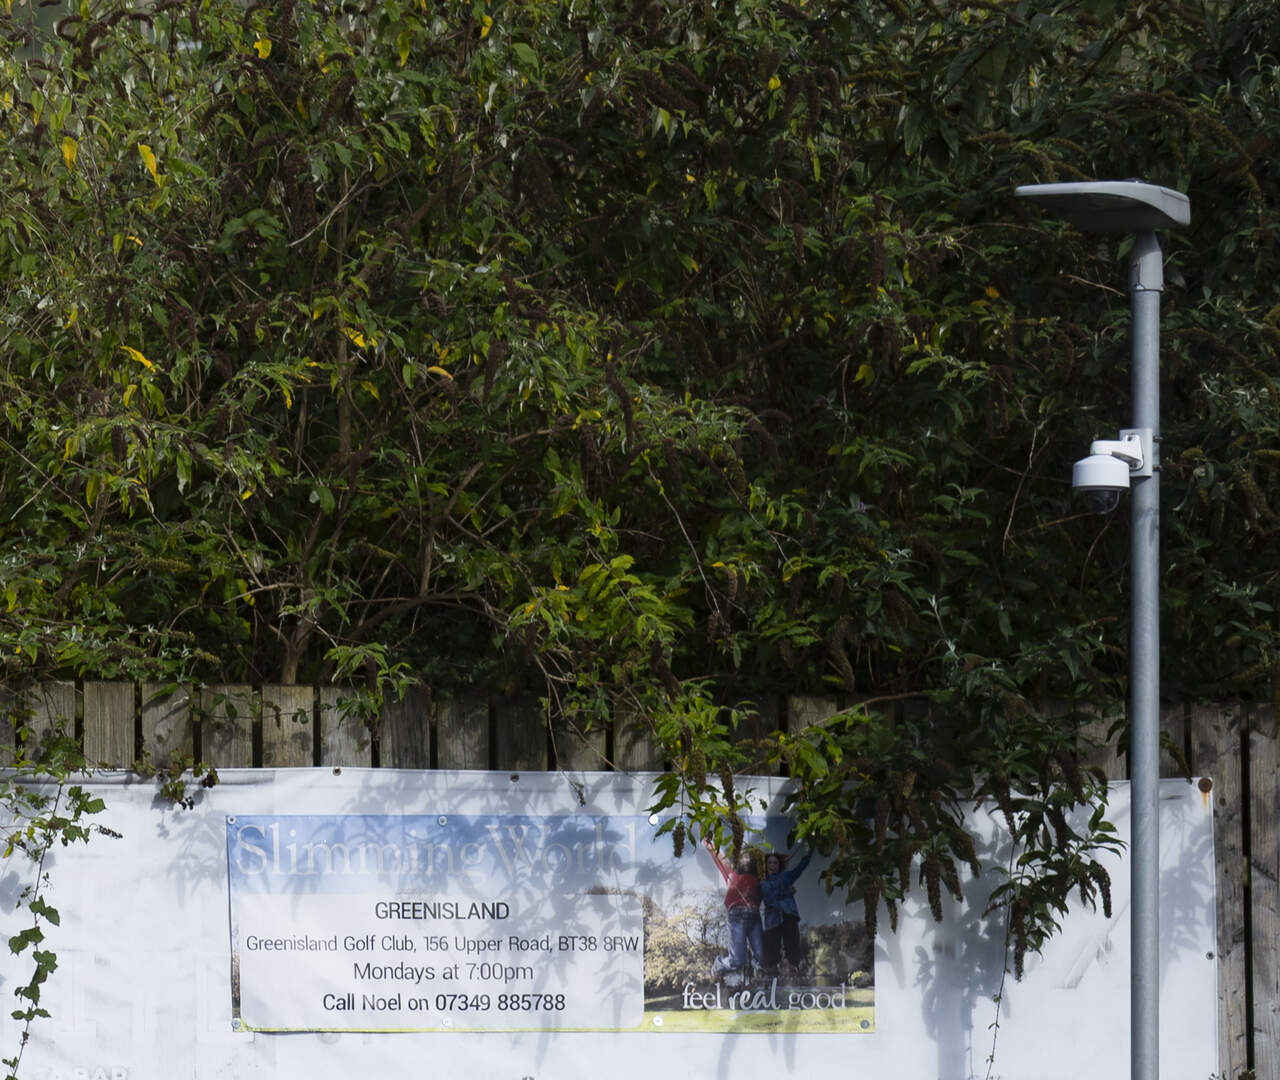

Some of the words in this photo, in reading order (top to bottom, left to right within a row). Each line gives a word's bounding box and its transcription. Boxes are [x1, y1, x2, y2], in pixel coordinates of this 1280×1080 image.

[375, 901, 510, 921] GREENISLAND
[246, 935, 338, 952] Greenisland
[343, 934, 376, 952] Golf
[381, 935, 417, 953] Club,
[423, 935, 449, 952] 156
[454, 936, 504, 956] Upper
[508, 935, 553, 953] Road,
[558, 935, 598, 952] BT38
[603, 935, 639, 952] 8RW
[353, 961, 436, 985] Mondays
[442, 964, 460, 981] at
[467, 962, 534, 985] 7:00pm
[322, 992, 355, 1011] Call
[362, 992, 402, 1011] Noel
[407, 998, 430, 1011] on
[435, 993, 491, 1012] 07349
[497, 993, 566, 1011] 885788
[682, 982, 722, 1010] feel
[728, 977, 781, 1010] real
[789, 983, 846, 1014] good
